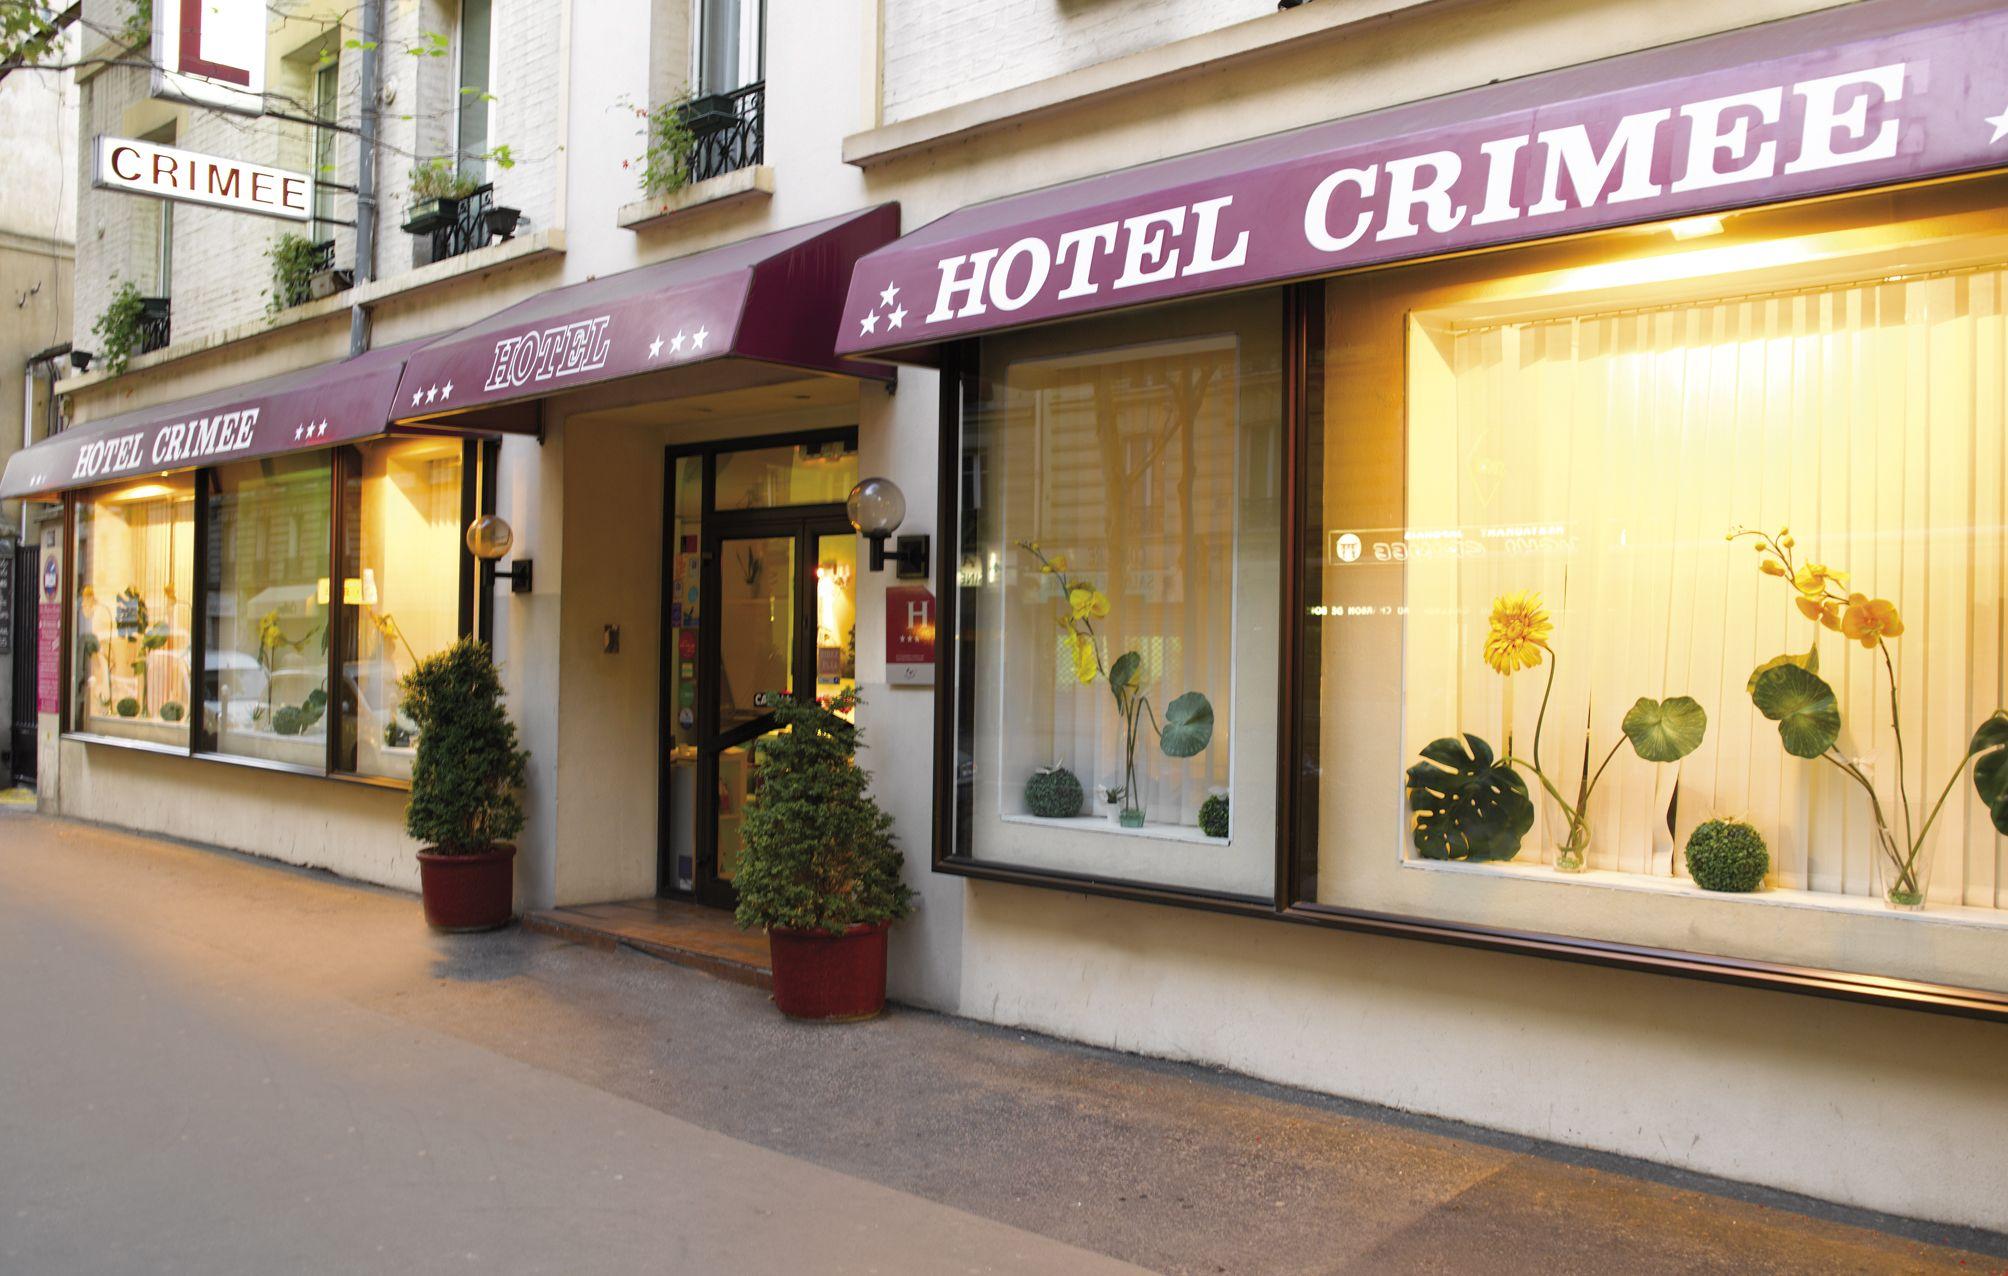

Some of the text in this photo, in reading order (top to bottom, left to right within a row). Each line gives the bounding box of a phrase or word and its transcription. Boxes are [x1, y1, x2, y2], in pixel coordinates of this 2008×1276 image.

[111, 147, 305, 211] CRIMEE
[924, 62, 1911, 325] HOTEL CRIMEE
[484, 314, 611, 391] HOTEL
[72, 407, 260, 480] HOTEL CRIMEE
[906, 600, 930, 629] H
